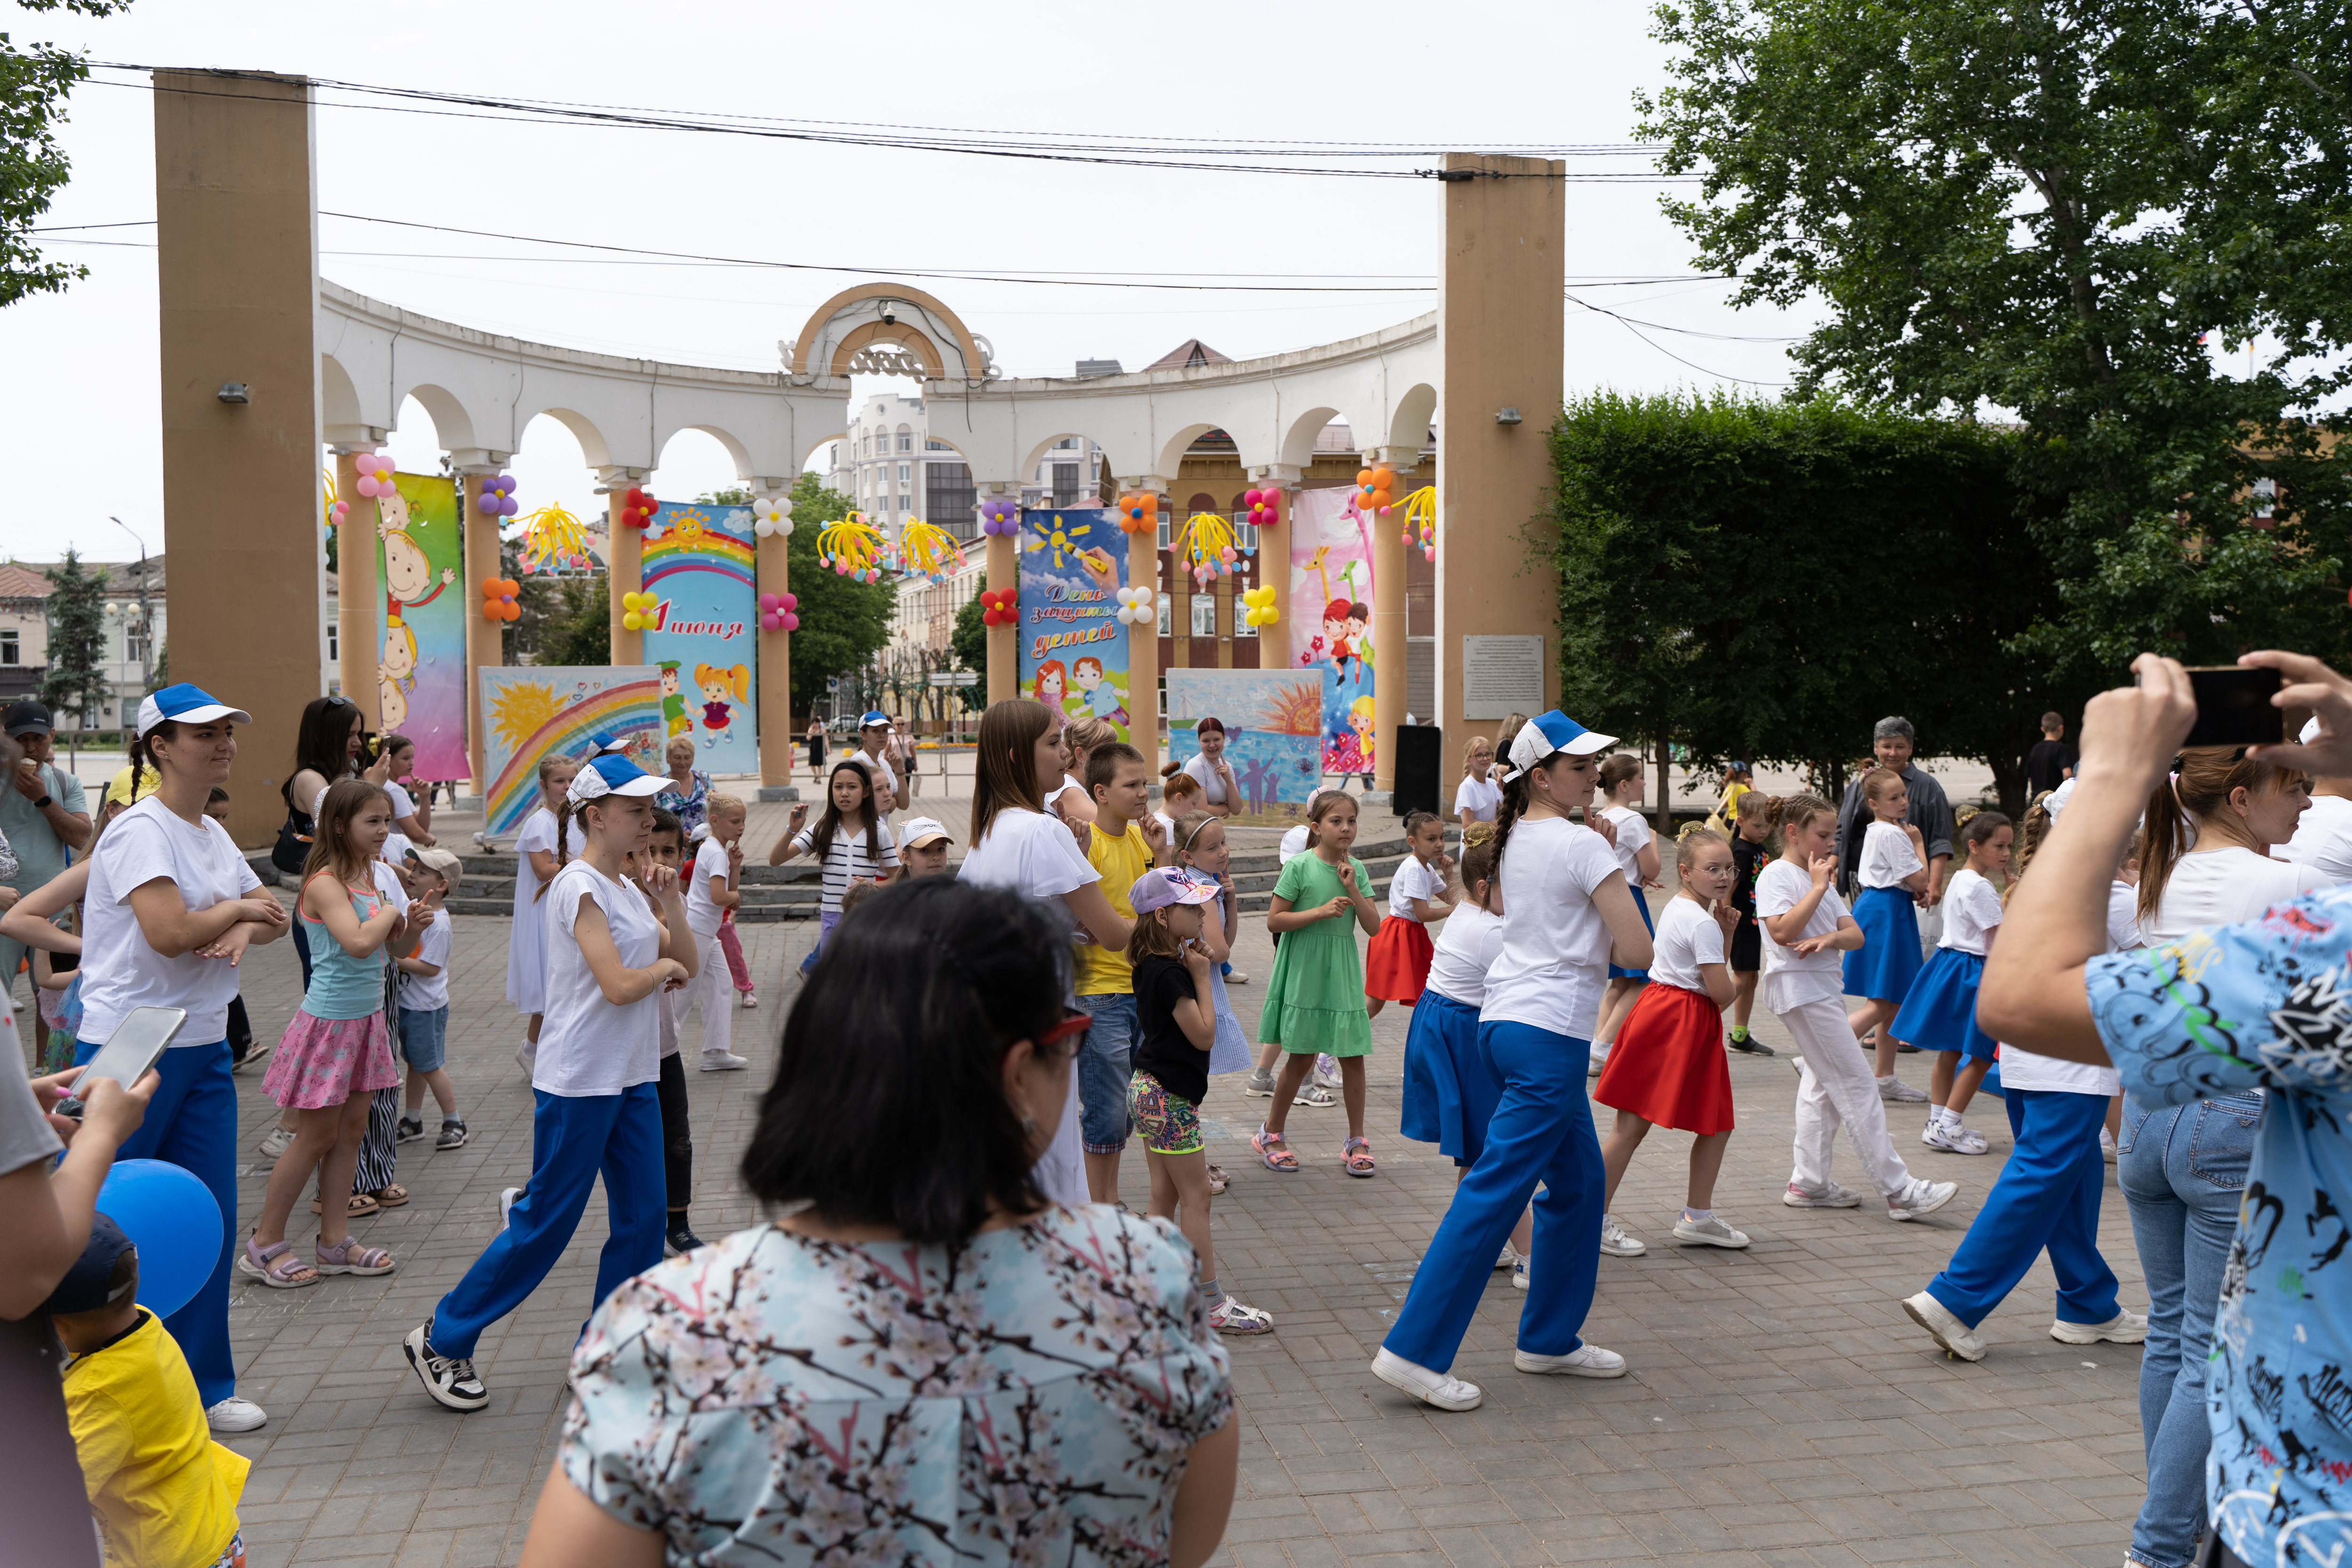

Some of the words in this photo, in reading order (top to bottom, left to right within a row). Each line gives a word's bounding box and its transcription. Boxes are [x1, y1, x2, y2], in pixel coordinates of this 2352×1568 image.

[1045, 583, 1107, 602] День
[652, 598, 672, 633] 1
[670, 620, 746, 641] июня
[1030, 605, 1118, 623] защиты
[1031, 621, 1117, 659] детей
[1168, 1131, 1193, 1144] always
